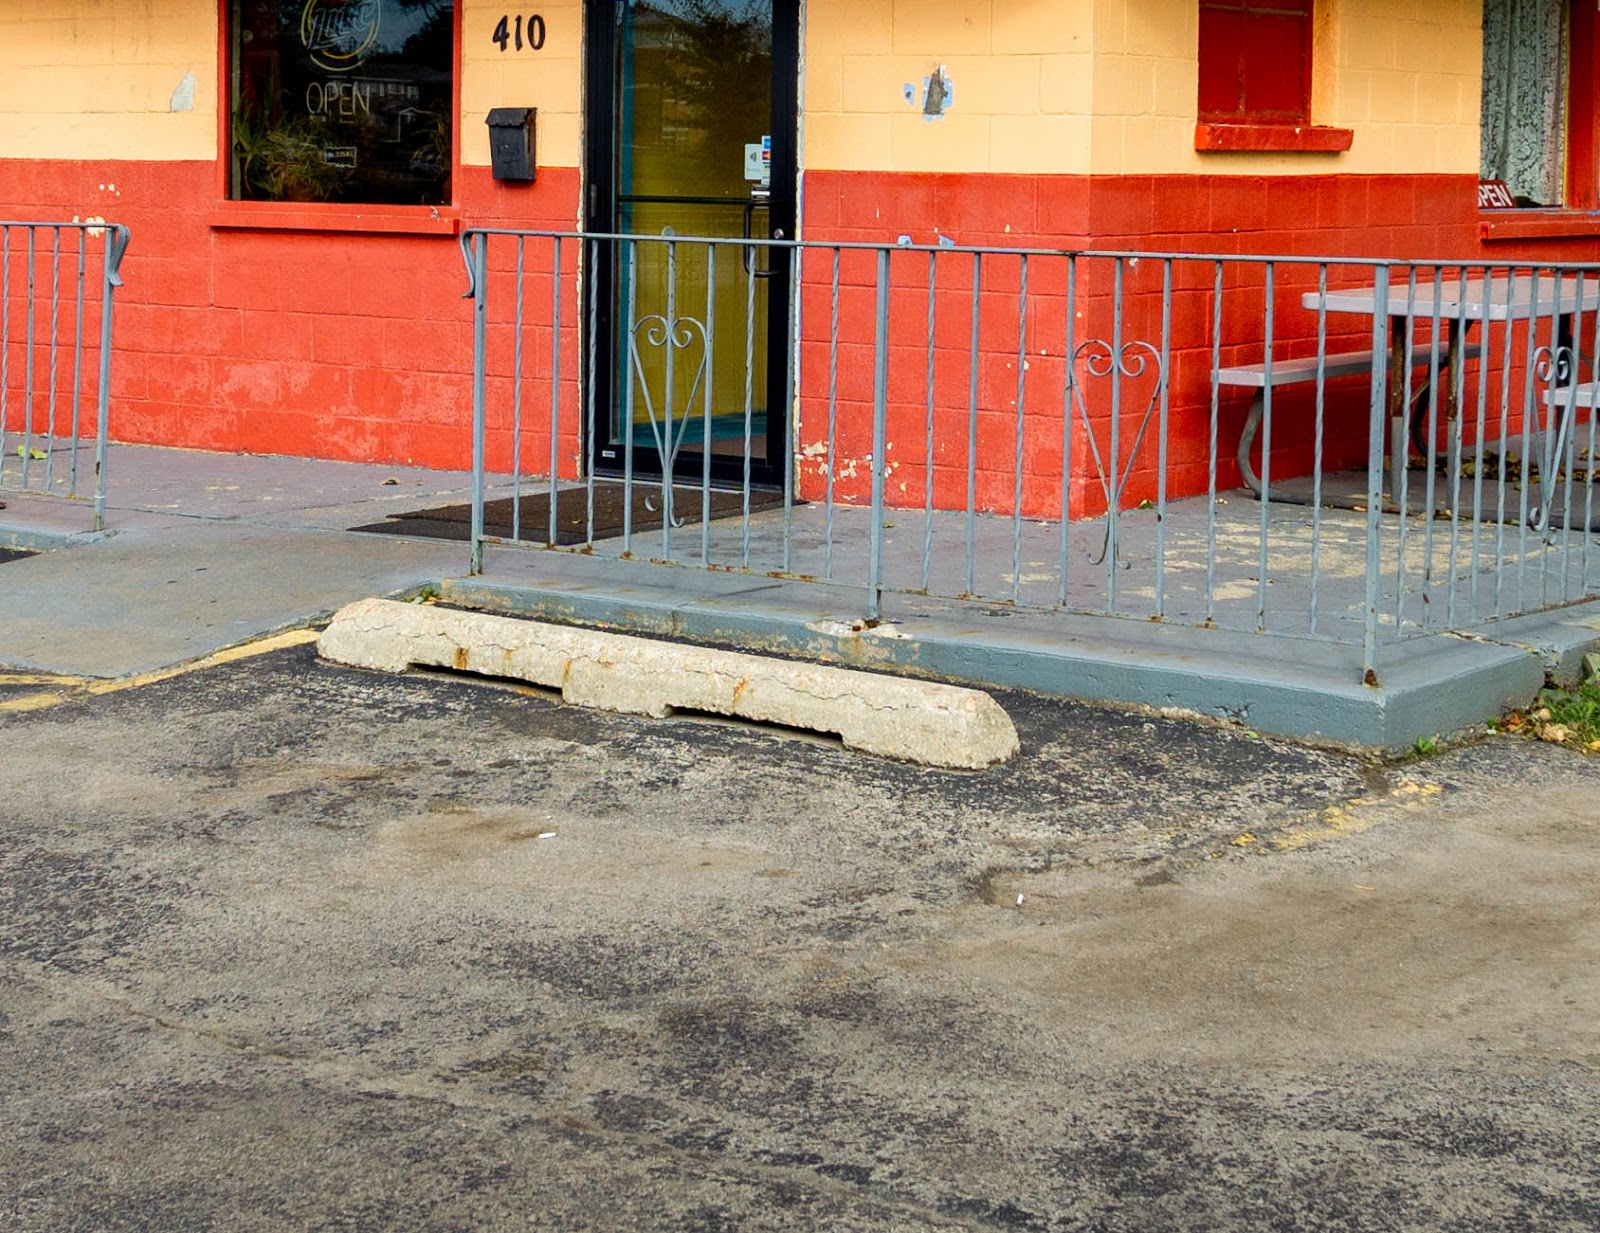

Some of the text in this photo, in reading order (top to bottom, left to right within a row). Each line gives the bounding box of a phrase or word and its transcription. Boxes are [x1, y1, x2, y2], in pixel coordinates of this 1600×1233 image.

[493, 14, 546, 52] 410
[306, 81, 370, 116] OPEN
[1478, 184, 1513, 207] PEN
